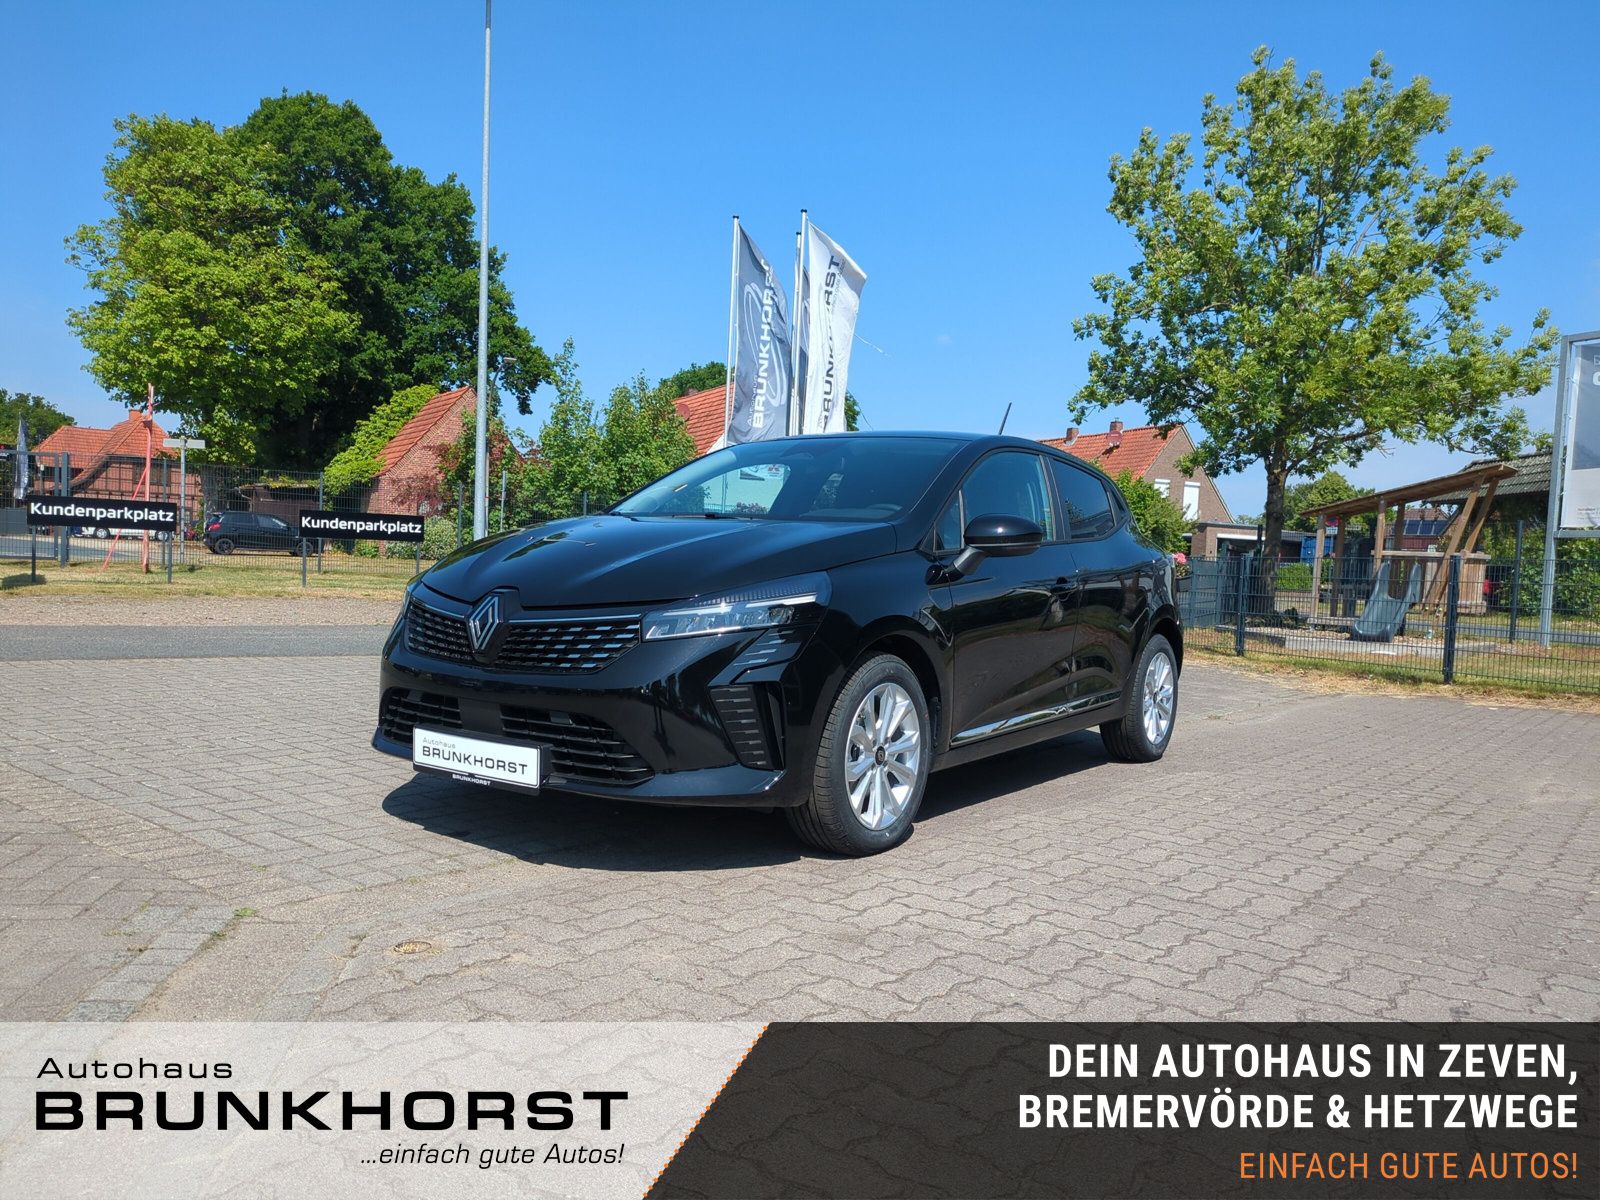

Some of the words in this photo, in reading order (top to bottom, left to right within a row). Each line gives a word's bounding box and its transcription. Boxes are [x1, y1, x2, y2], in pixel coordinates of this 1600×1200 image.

[30, 502, 174, 522] Kundenparkplatz
[301, 516, 422, 534] Kundenparkplatz
[423, 737, 456, 749] Autohaus
[422, 746, 528, 775] BRUNKHORST
[452, 773, 491, 786] BRUNKHORST
